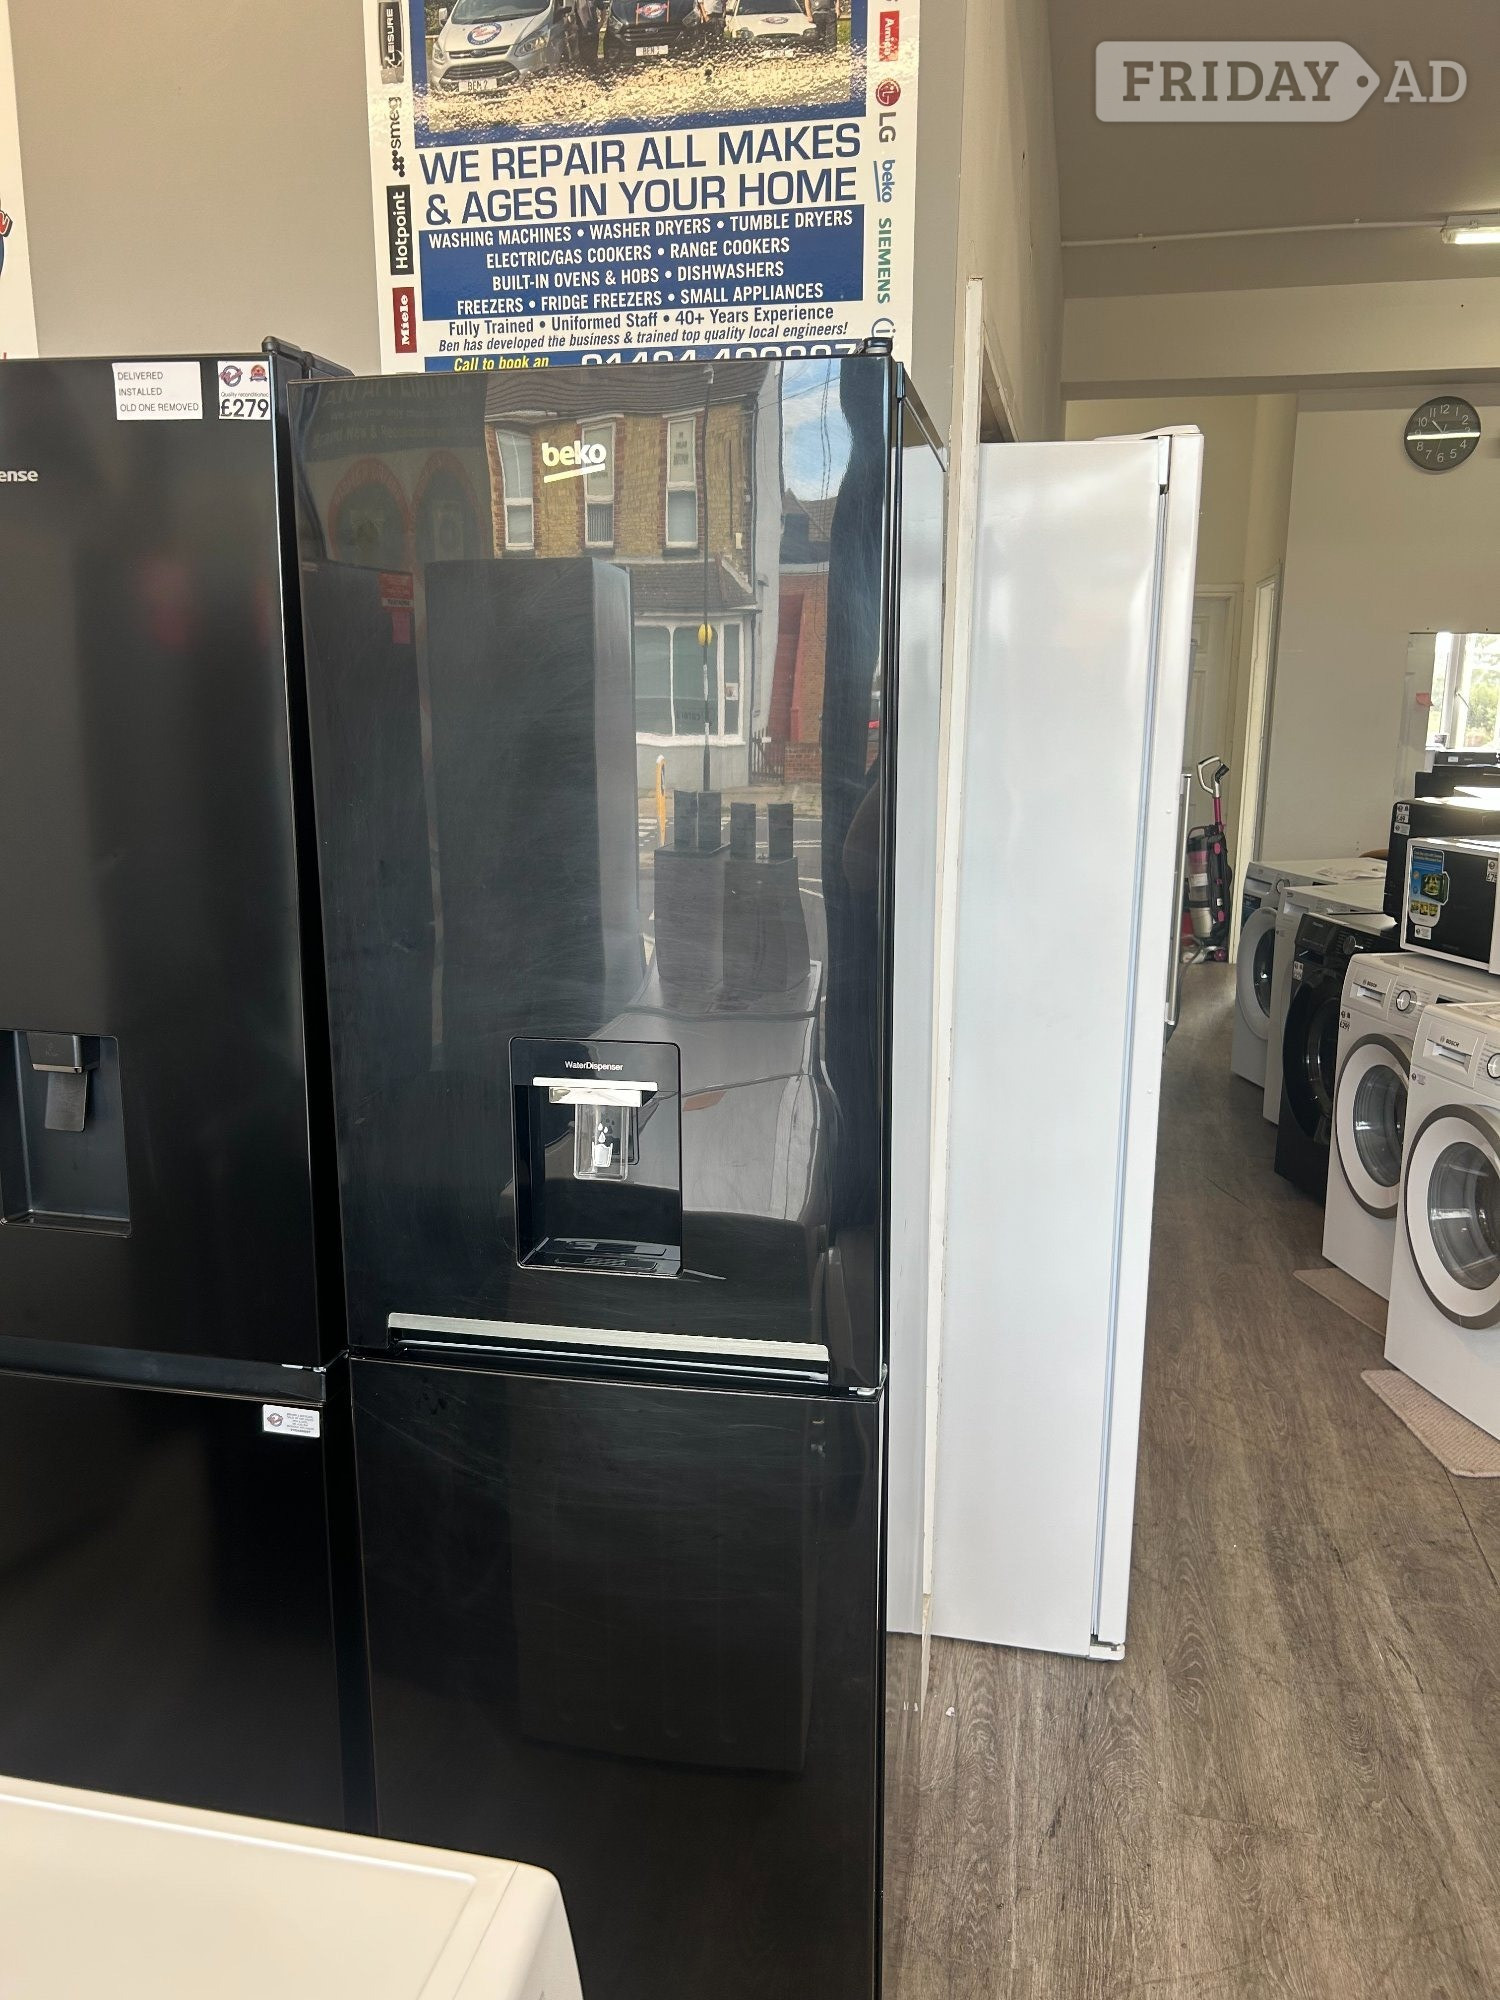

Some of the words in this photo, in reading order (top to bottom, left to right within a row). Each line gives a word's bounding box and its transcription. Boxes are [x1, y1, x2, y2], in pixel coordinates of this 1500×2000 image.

[386, 8, 396, 62] LEISURE
[388, 96, 402, 149] smeg
[878, 111, 897, 143] LG
[419, 150, 480, 185] WE
[492, 139, 626, 181] REPAIR
[637, 134, 707, 172] ALL
[718, 122, 861, 166] MAKES
[426, 193, 452, 226] &
[462, 186, 558, 224] AGES
[569, 182, 607, 218] IN
[619, 174, 726, 214] YOUR
[739, 167, 857, 207] HOME
[880, 159, 896, 203] beko
[392, 192, 410, 270] Hotpoint
[429, 230, 493, 249] WASHING
[499, 226, 572, 246] MACHINES
[589, 221, 650, 240] WASHER
[655, 218, 711, 236] DRYERS
[730, 213, 790, 232] TUMBLE
[795, 210, 853, 228] DRYERS
[486, 250, 582, 269] ELECTRIC/GAS
[587, 245, 651, 263] COOKERS
[670, 240, 718, 259] RANGE
[723, 237, 790, 255] COOKERS
[877, 217, 891, 304] SIEMENS
[493, 273, 550, 291] BUILT-IN
[554, 270, 600, 288] OVENS
[605, 270, 617, 285] &
[621, 267, 659, 284] HOBS
[677, 261, 784, 282] DISHWASHERS
[457, 297, 523, 315] FREEZERS
[541, 293, 589, 311] FRIDGE
[593, 290, 662, 309] FREEZERS
[680, 287, 728, 305] SMALL
[732, 282, 824, 303] APPLIANCES
[400, 294, 410, 346] Miele
[449, 320, 480, 338] Fully
[484, 318, 534, 335] Trained
[551, 313, 621, 332] Uniformed
[626, 311, 658, 329] Staff
[675, 310, 705, 326] 40+
[709, 308, 749, 325] Years
[754, 304, 834, 325] Experience
[438, 339, 460, 353] Ben
[463, 338, 483, 352] has
[486, 333, 545, 352] developed
[548, 333, 566, 348] the
[569, 330, 620, 347] business
[623, 331, 634, 344] &
[636, 327, 678, 344] trained
[681, 328, 700, 343] top
[704, 325, 745, 342] quality
[749, 324, 779, 339] local
[782, 321, 849, 339] engineers!
[118, 372, 163, 380] DELIVERED
[454, 356, 479, 372] Call
[482, 357, 494, 370] to
[498, 355, 529, 370] book
[533, 356, 550, 368] an
[119, 388, 162, 396] INSTALLED
[120, 404, 136, 412] OLD
[139, 404, 155, 412] ONE
[158, 403, 199, 412] REMOVED
[221, 399, 269, 417] £279
[542, 440, 607, 467] beko
[0, 470, 38, 482] ense
[1445, 1038, 1459, 1047] BOSCH
[564, 1061, 625, 1071] WaterDispenser
